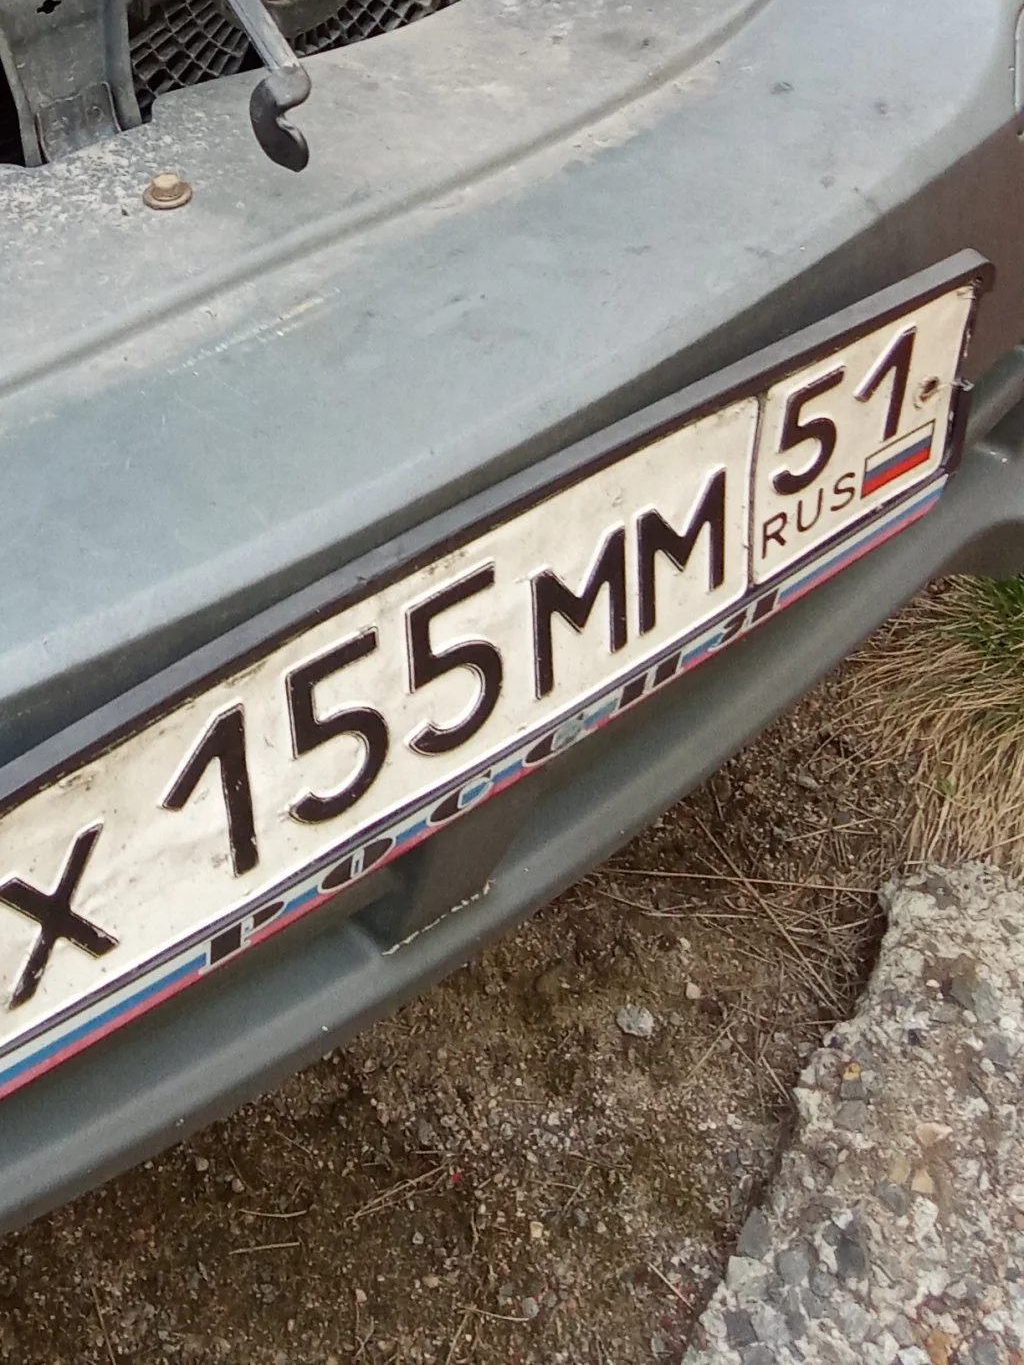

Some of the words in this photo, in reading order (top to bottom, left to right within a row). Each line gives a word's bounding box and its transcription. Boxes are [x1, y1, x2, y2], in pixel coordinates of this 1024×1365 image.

[771, 326, 917, 495] 51
[762, 472, 856, 559] RUS
[209, 587, 782, 972] РОССИЯ
